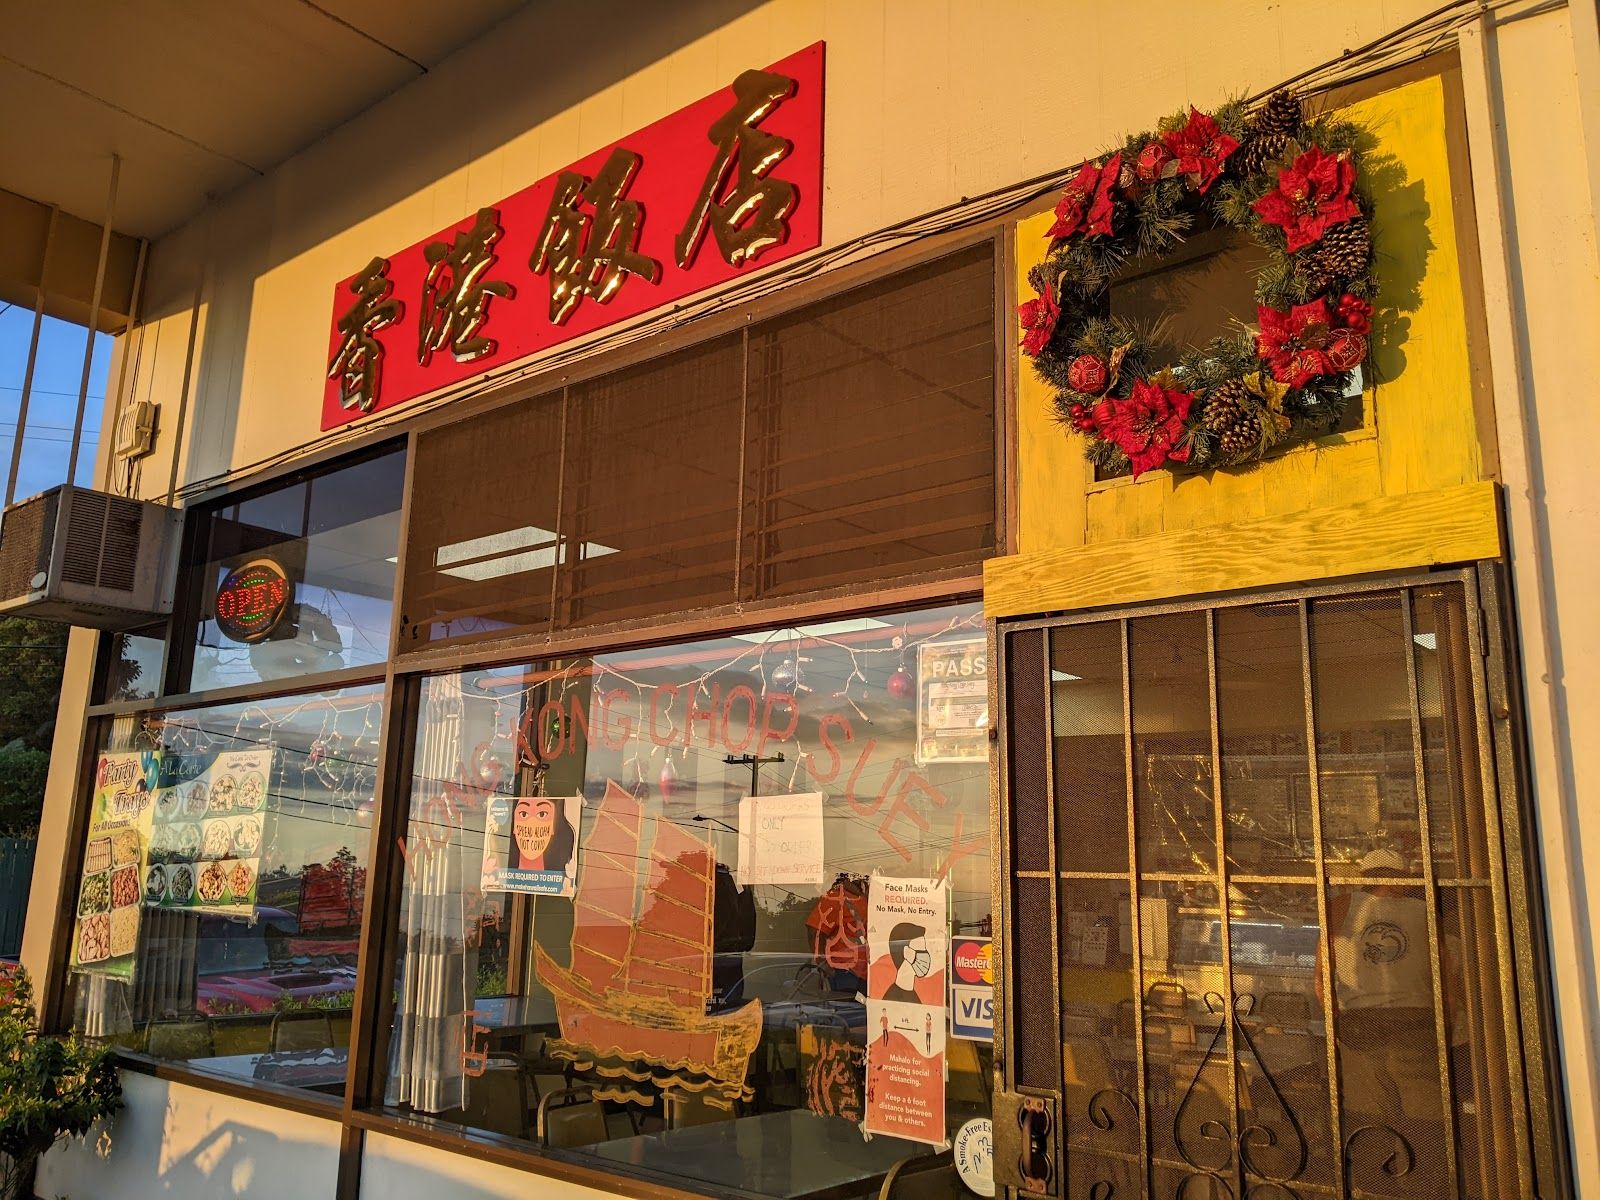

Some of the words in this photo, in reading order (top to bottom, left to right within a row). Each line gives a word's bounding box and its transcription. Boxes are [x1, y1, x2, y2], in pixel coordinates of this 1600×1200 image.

[327, 68, 799, 414] 香港飯店
[218, 577, 284, 619] OPEN
[933, 657, 986, 677] PASS
[104, 759, 138, 788] Party
[397, 741, 504, 882] HONG
[509, 687, 632, 774] KONG
[650, 682, 799, 757] CHOP
[806, 714, 990, 890] SUEY
[114, 789, 151, 819] Trays
[516, 824, 533, 838] SPREAD
[534, 824, 551, 838] ALOHA
[530, 839, 546, 852] COVID
[498, 872, 515, 880] MASK
[516, 872, 539, 882] REQUIRED
[540, 874, 547, 882] TO
[547, 874, 563, 883] ENTER
[885, 883, 903, 892] Face
[905, 884, 928, 893] Masks
[884, 895, 928, 905] REQUIRED.
[887, 905, 906, 914] Mask,
[918, 908, 937, 917] Entry.
[889, 1054, 910, 1065] Mahalo
[912, 1057, 921, 1065] for
[882, 1062, 911, 1076] practicing
[912, 1067, 930, 1077] social
[889, 1074, 921, 1087] distancing.
[885, 1092, 901, 1104] Keep
[912, 1098, 926, 1107] foot
[879, 1102, 904, 1114] distance
[905, 1105, 933, 1118] between
[884, 1113, 897, 1123] you
[904, 1115, 926, 1127] others.
[962, 1165, 971, 1174] A
